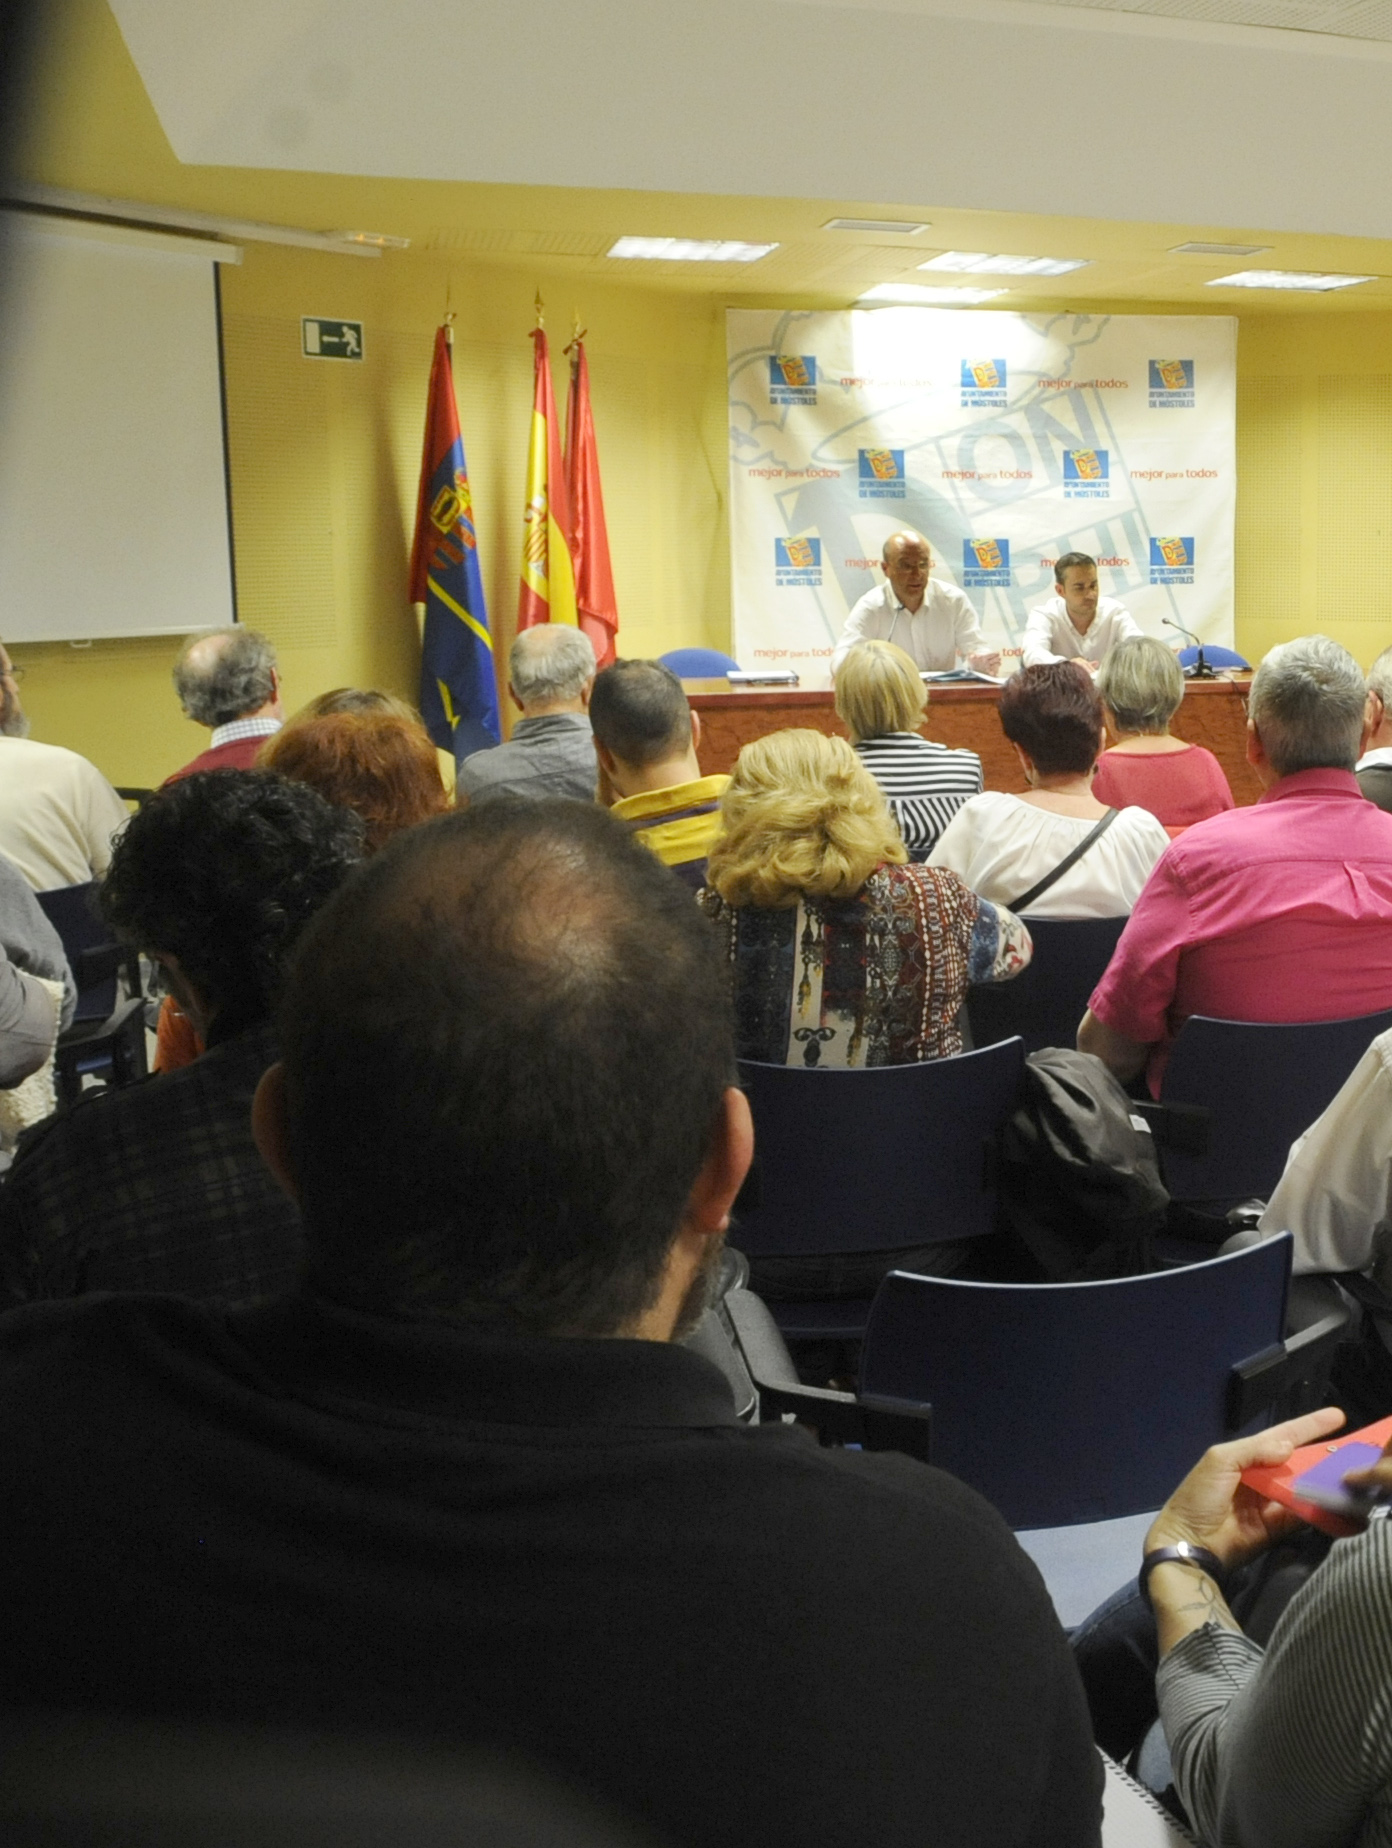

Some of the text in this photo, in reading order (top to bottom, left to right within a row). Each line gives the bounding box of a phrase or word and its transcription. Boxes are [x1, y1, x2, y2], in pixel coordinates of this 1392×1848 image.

[1038, 378, 1072, 390] mejor
[1095, 378, 1129, 388] todos
[749, 469, 783, 480] mejor
[806, 468, 840, 478] todos
[942, 470, 976, 481] mejor
[1000, 469, 1033, 479] todos
[1130, 469, 1164, 481] mejor
[1186, 468, 1218, 478] todos
[845, 558, 879, 570] mejor
[1097, 556, 1130, 567] todos
[754, 647, 789, 660] mejor
[812, 647, 834, 657] tod
[1003, 647, 1024, 657] tod
